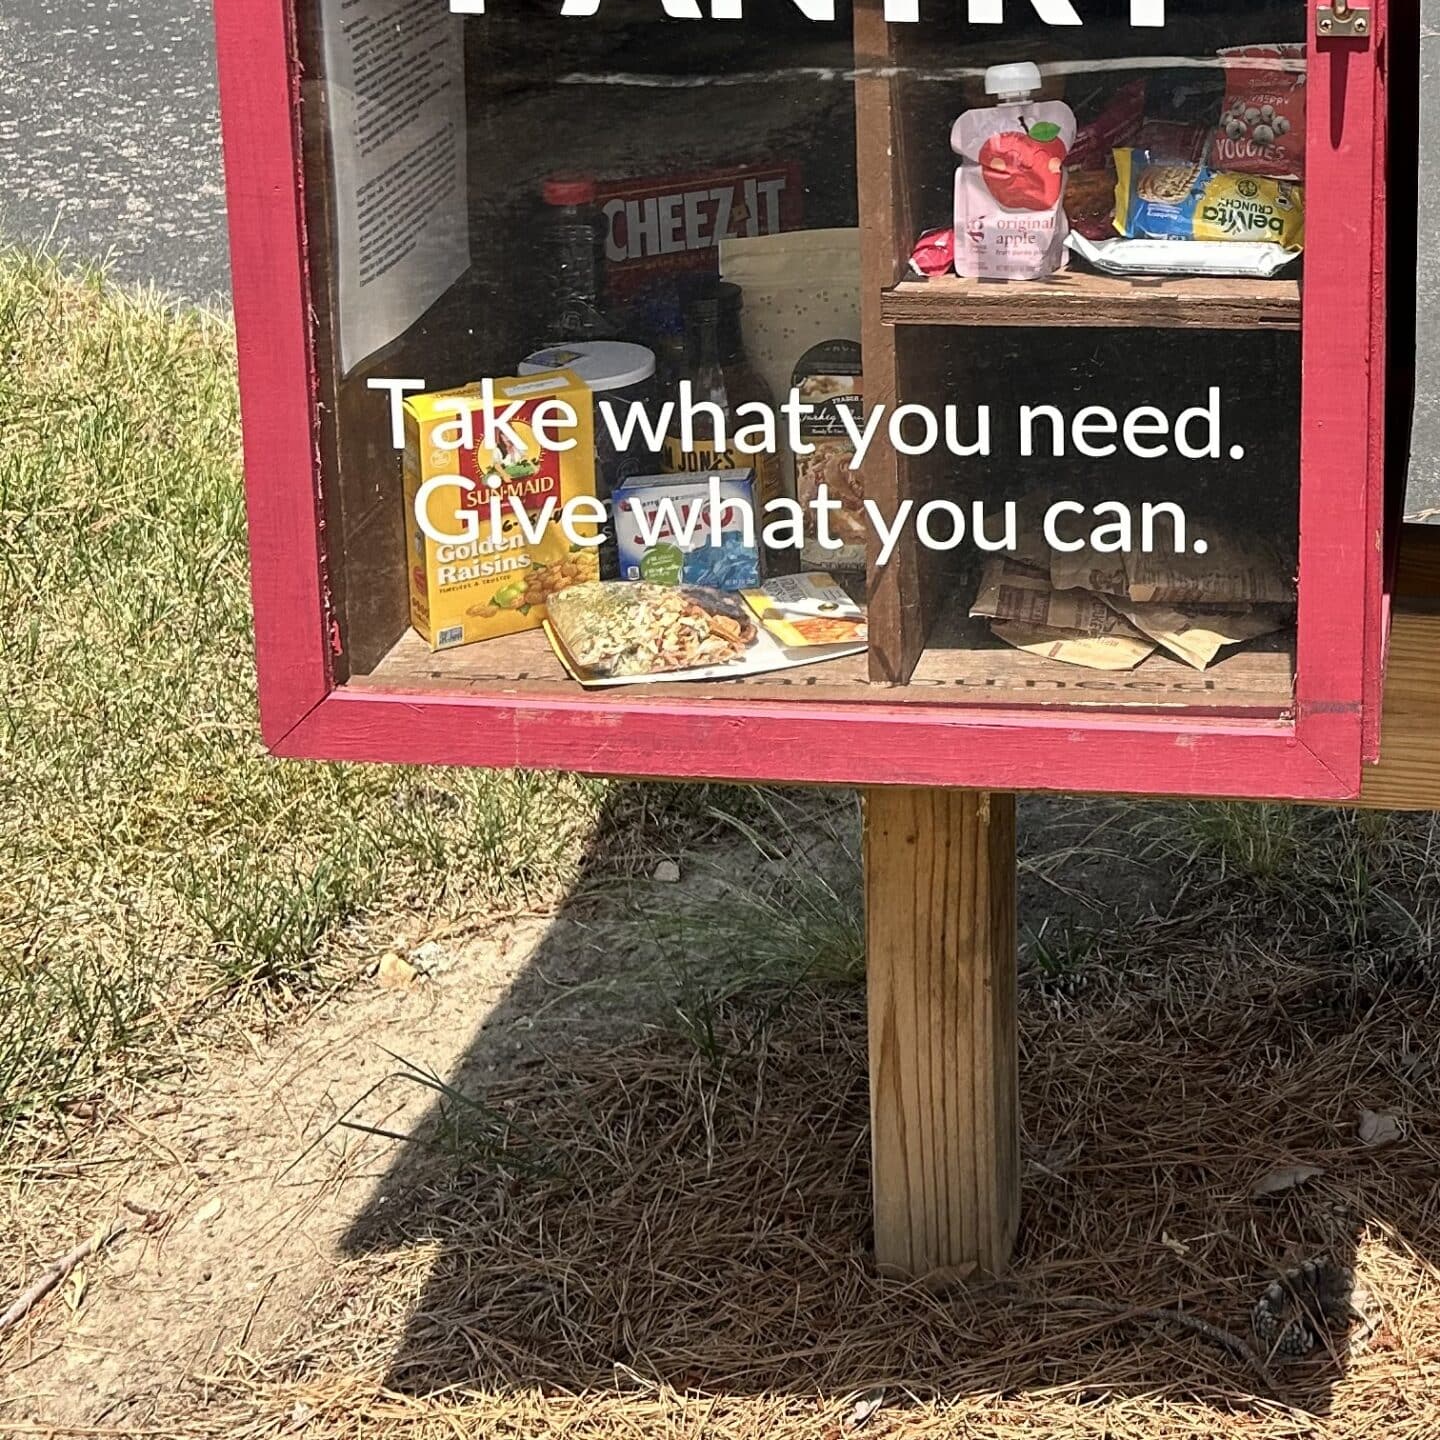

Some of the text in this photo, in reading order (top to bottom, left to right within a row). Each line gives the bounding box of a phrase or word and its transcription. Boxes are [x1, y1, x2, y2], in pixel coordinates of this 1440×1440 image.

[996, 217, 1056, 234] original
[996, 231, 1037, 246] apple
[366, 378, 1245, 471] Take what you need.
[414, 474, 1209, 566] Give what you can.
[435, 531, 526, 565] Golden
[438, 553, 532, 586] Raisins
